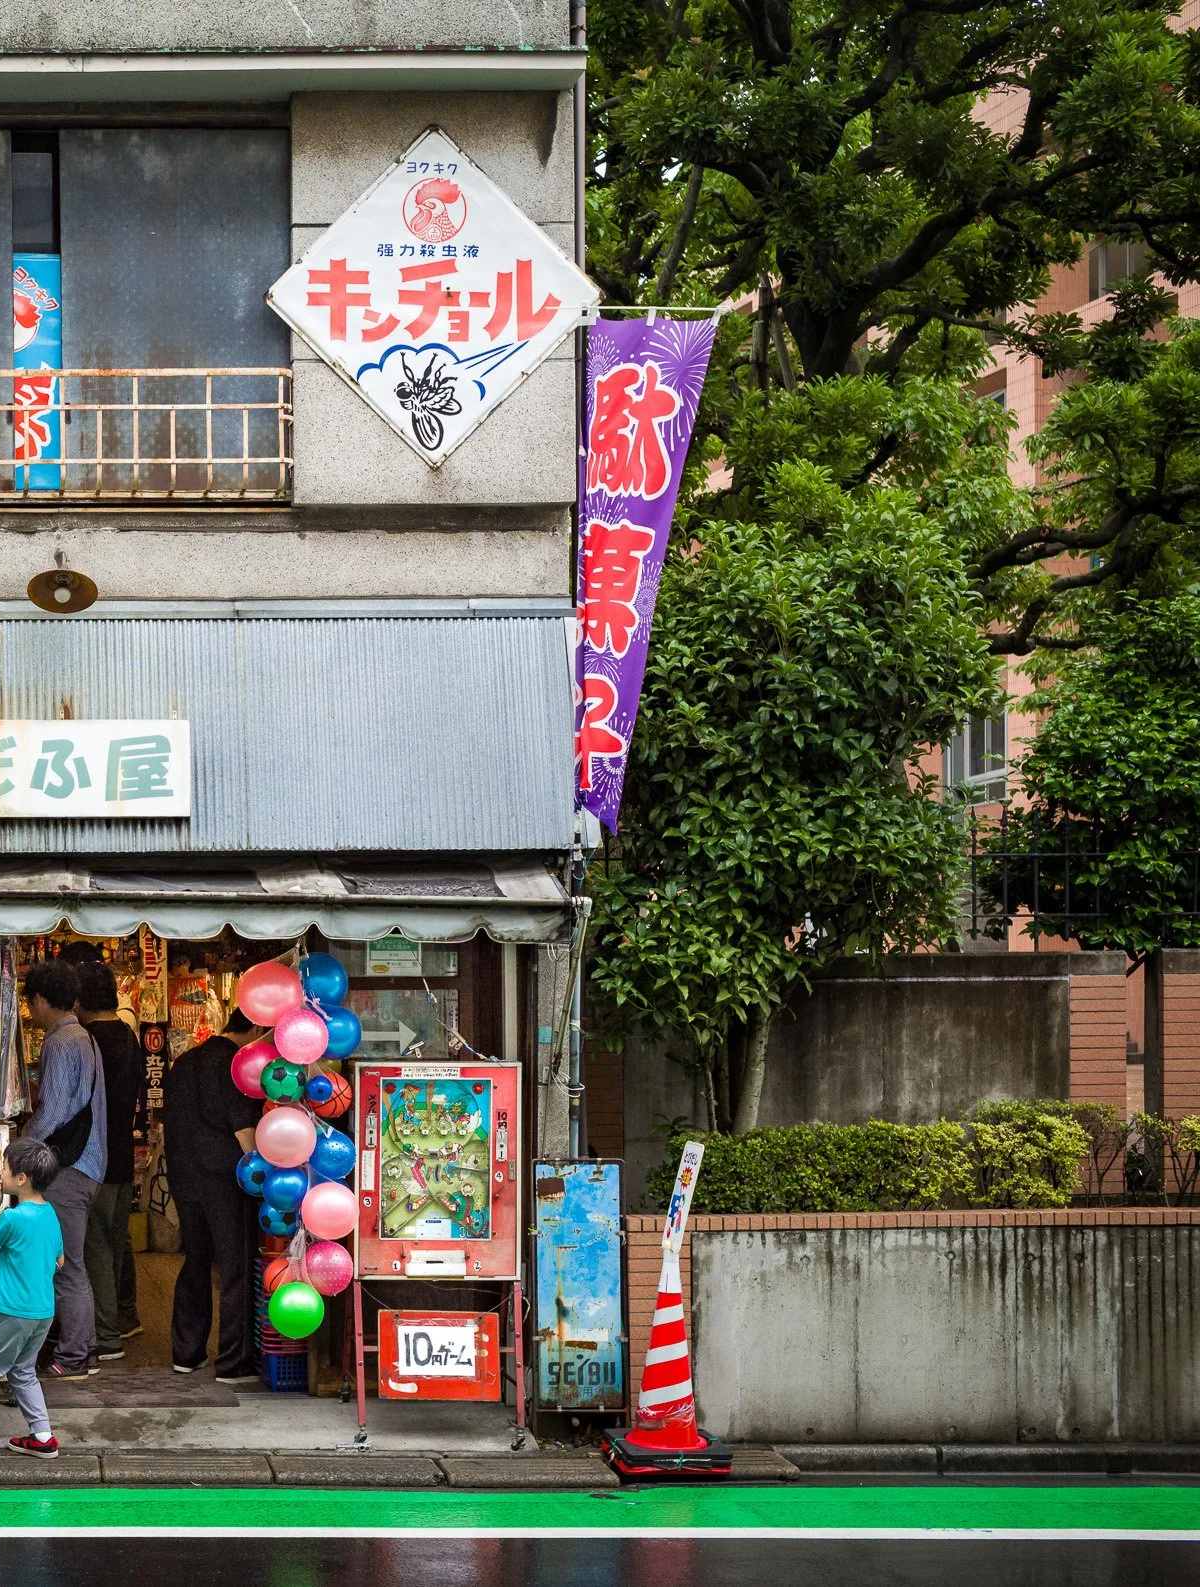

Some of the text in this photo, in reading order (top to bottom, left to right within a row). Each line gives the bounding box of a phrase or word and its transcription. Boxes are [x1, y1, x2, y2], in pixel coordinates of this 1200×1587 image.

[405, 161, 458, 175] ヨクキク
[307, 258, 562, 343] キンチョール
[548, 1354, 616, 1386] SEIBU
